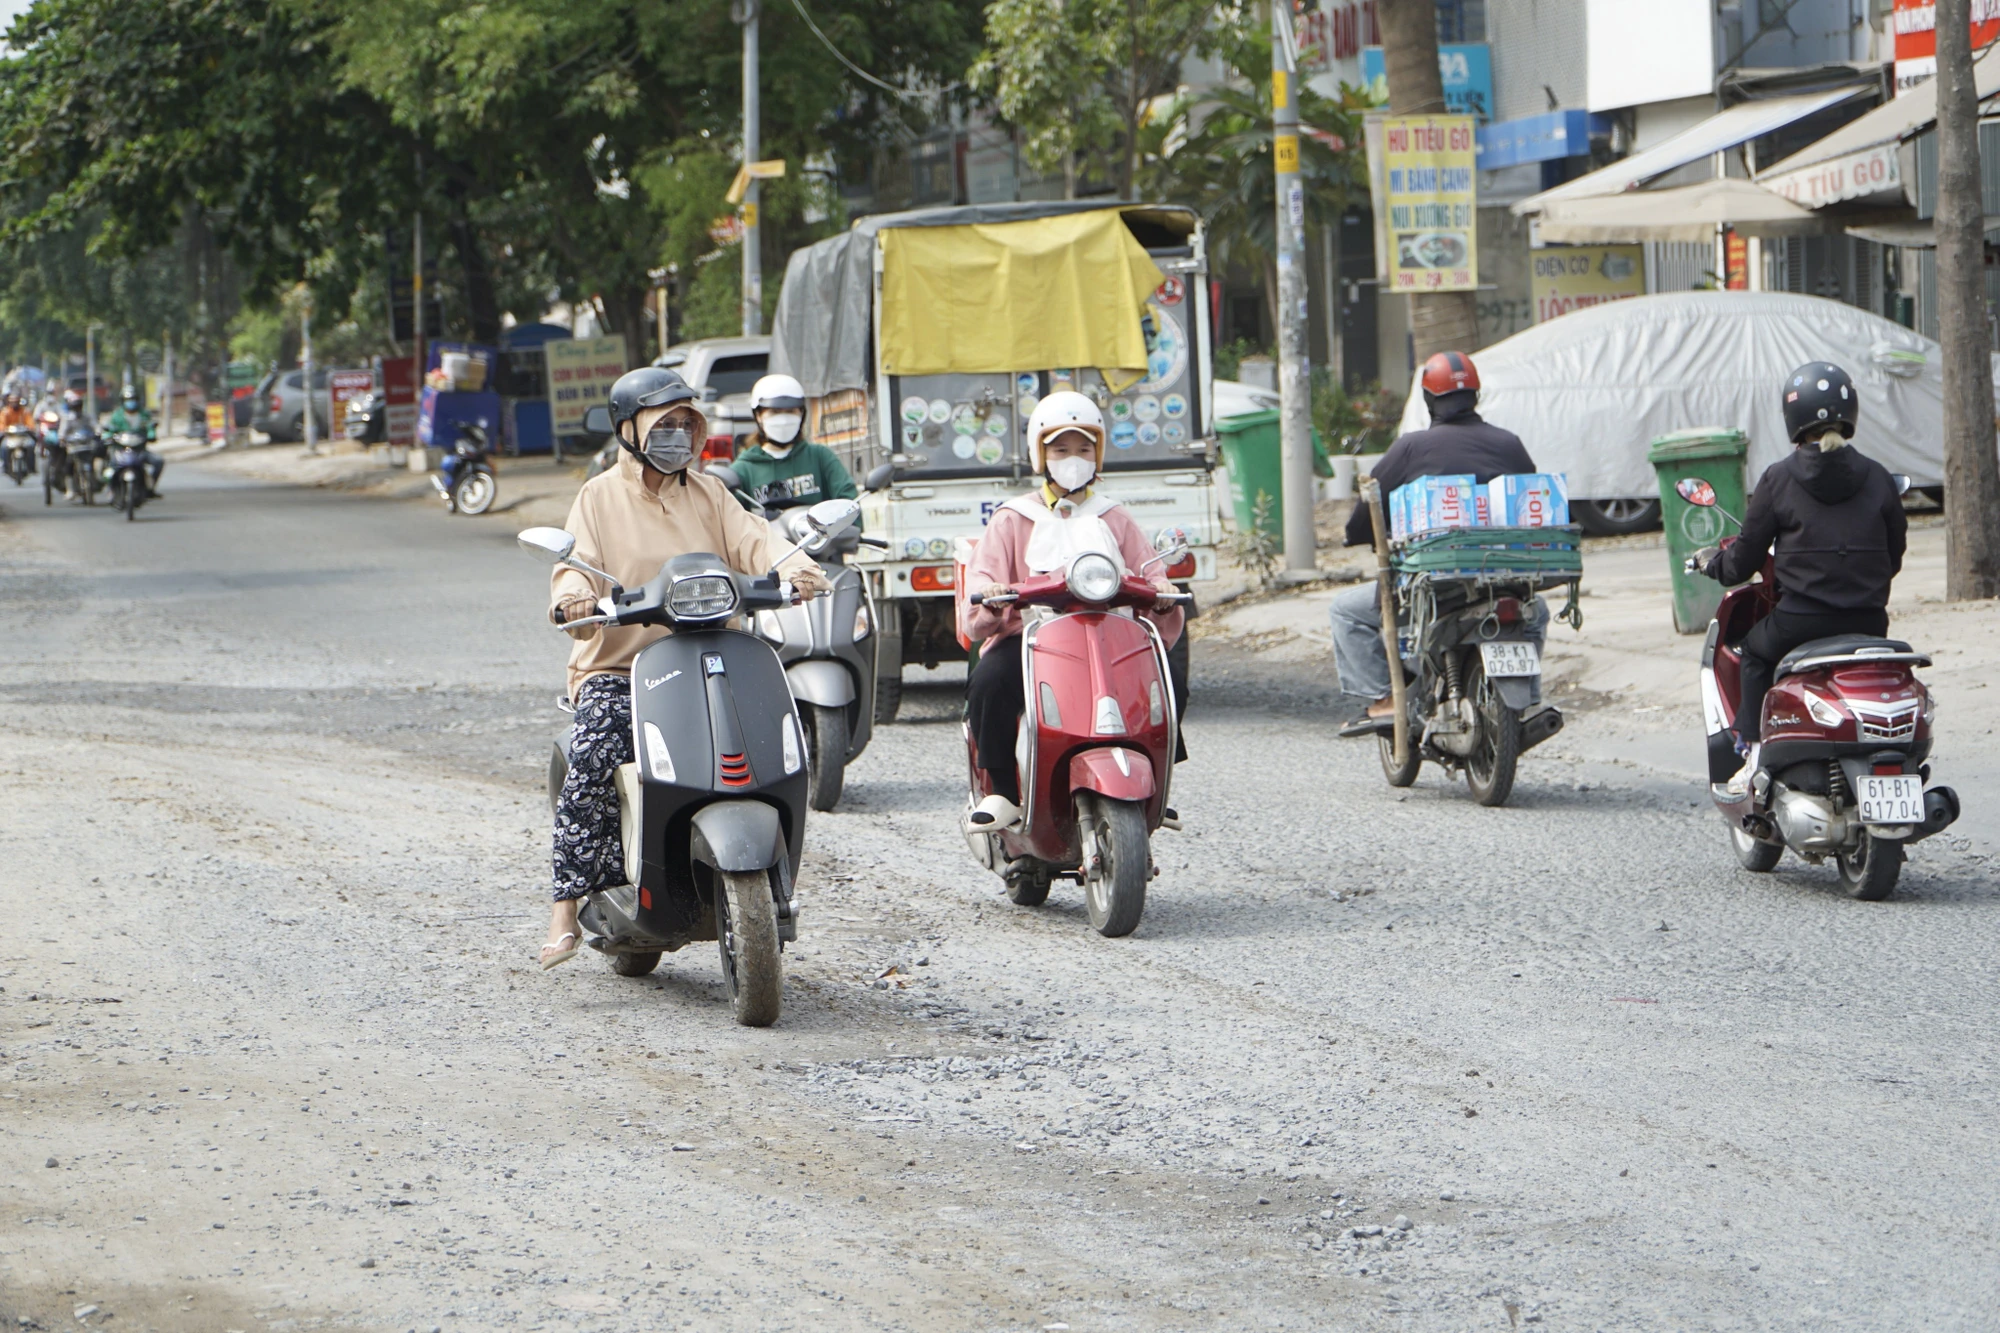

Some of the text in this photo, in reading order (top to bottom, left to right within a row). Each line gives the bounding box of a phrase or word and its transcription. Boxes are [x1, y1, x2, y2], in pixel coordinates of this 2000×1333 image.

[1442, 486, 1460, 520] Life
[644, 670, 682, 691] Vespa
[1868, 779, 1911, 798] 61-B1
[1863, 800, 1920, 820] 917.04
